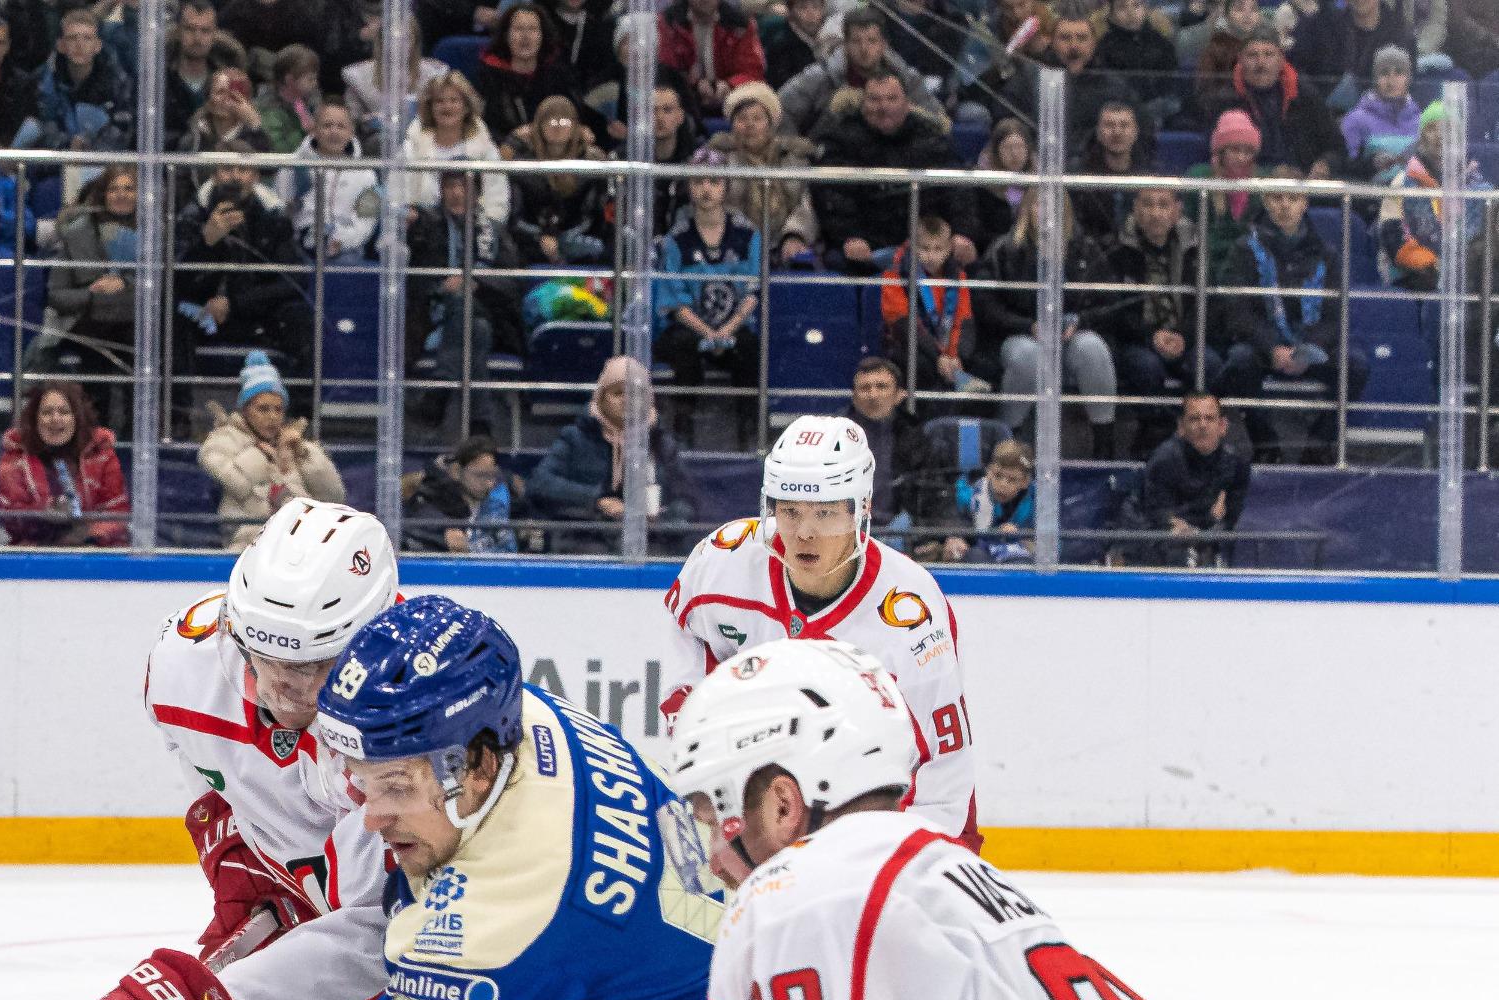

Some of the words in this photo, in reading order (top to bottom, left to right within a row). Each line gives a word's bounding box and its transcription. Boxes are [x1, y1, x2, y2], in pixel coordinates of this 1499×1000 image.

[796, 431, 824, 447] 90
[780, 483, 820, 494] согаз
[246, 626, 301, 650] согаз
[539, 726, 555, 772] LUTCH
[735, 724, 783, 750] CCM
